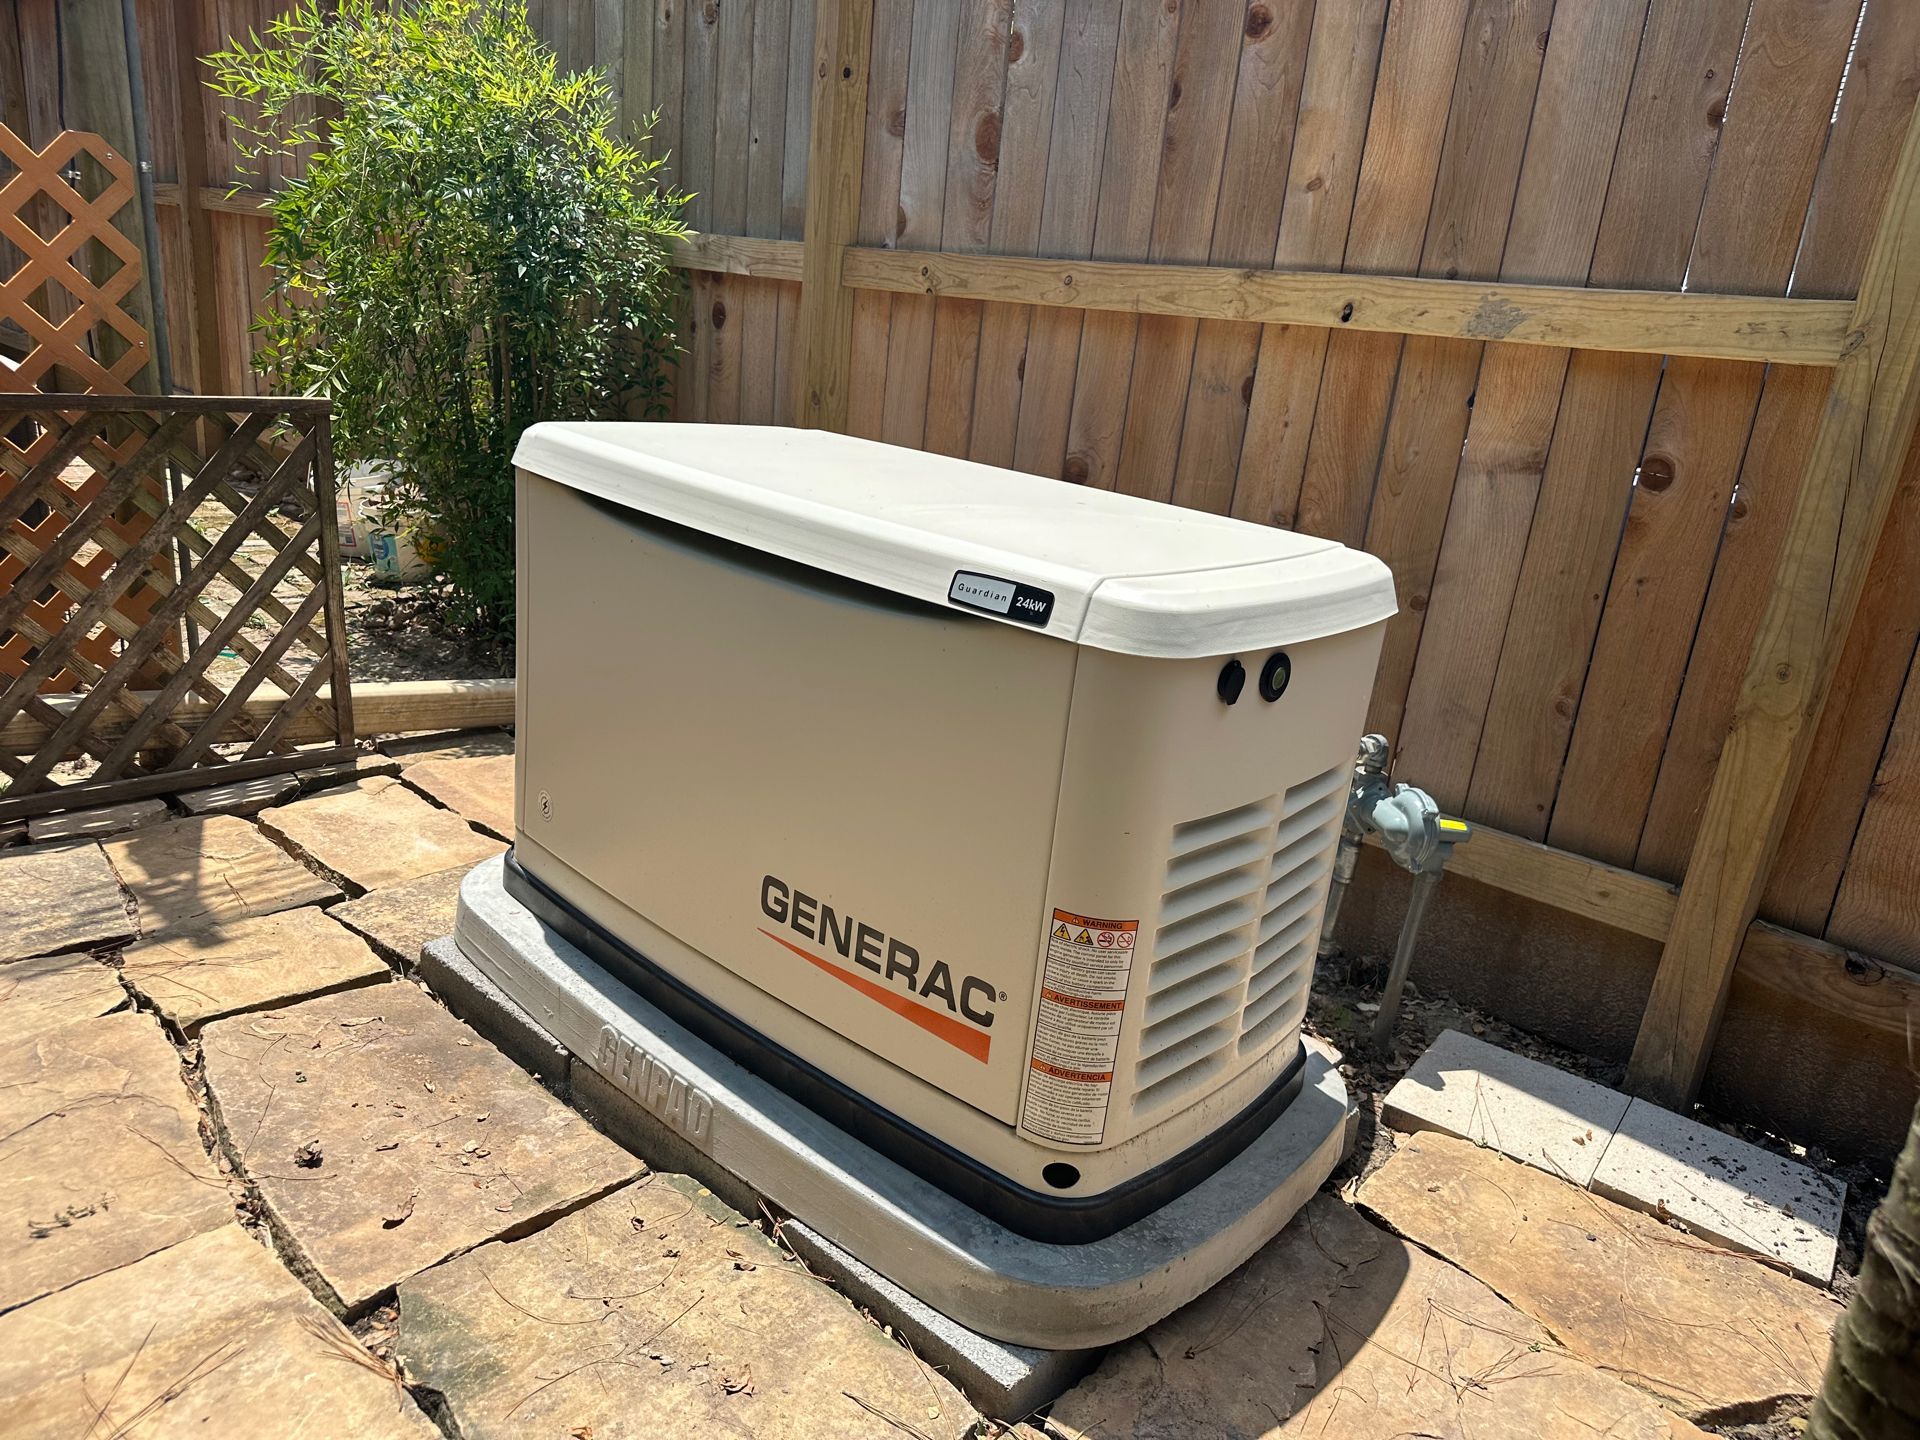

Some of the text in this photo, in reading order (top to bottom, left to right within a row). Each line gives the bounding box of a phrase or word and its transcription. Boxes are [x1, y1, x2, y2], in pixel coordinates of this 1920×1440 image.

[958, 583, 1047, 613] Guardian 24kW
[1082, 918, 1123, 930] WARNING
[761, 874, 996, 1028] GENERAC
[1054, 994, 1122, 1010] AVERTISSEMENT
[1048, 1066, 1106, 1081] ADVERTENCIA
[597, 1024, 714, 1150] GENPAD
